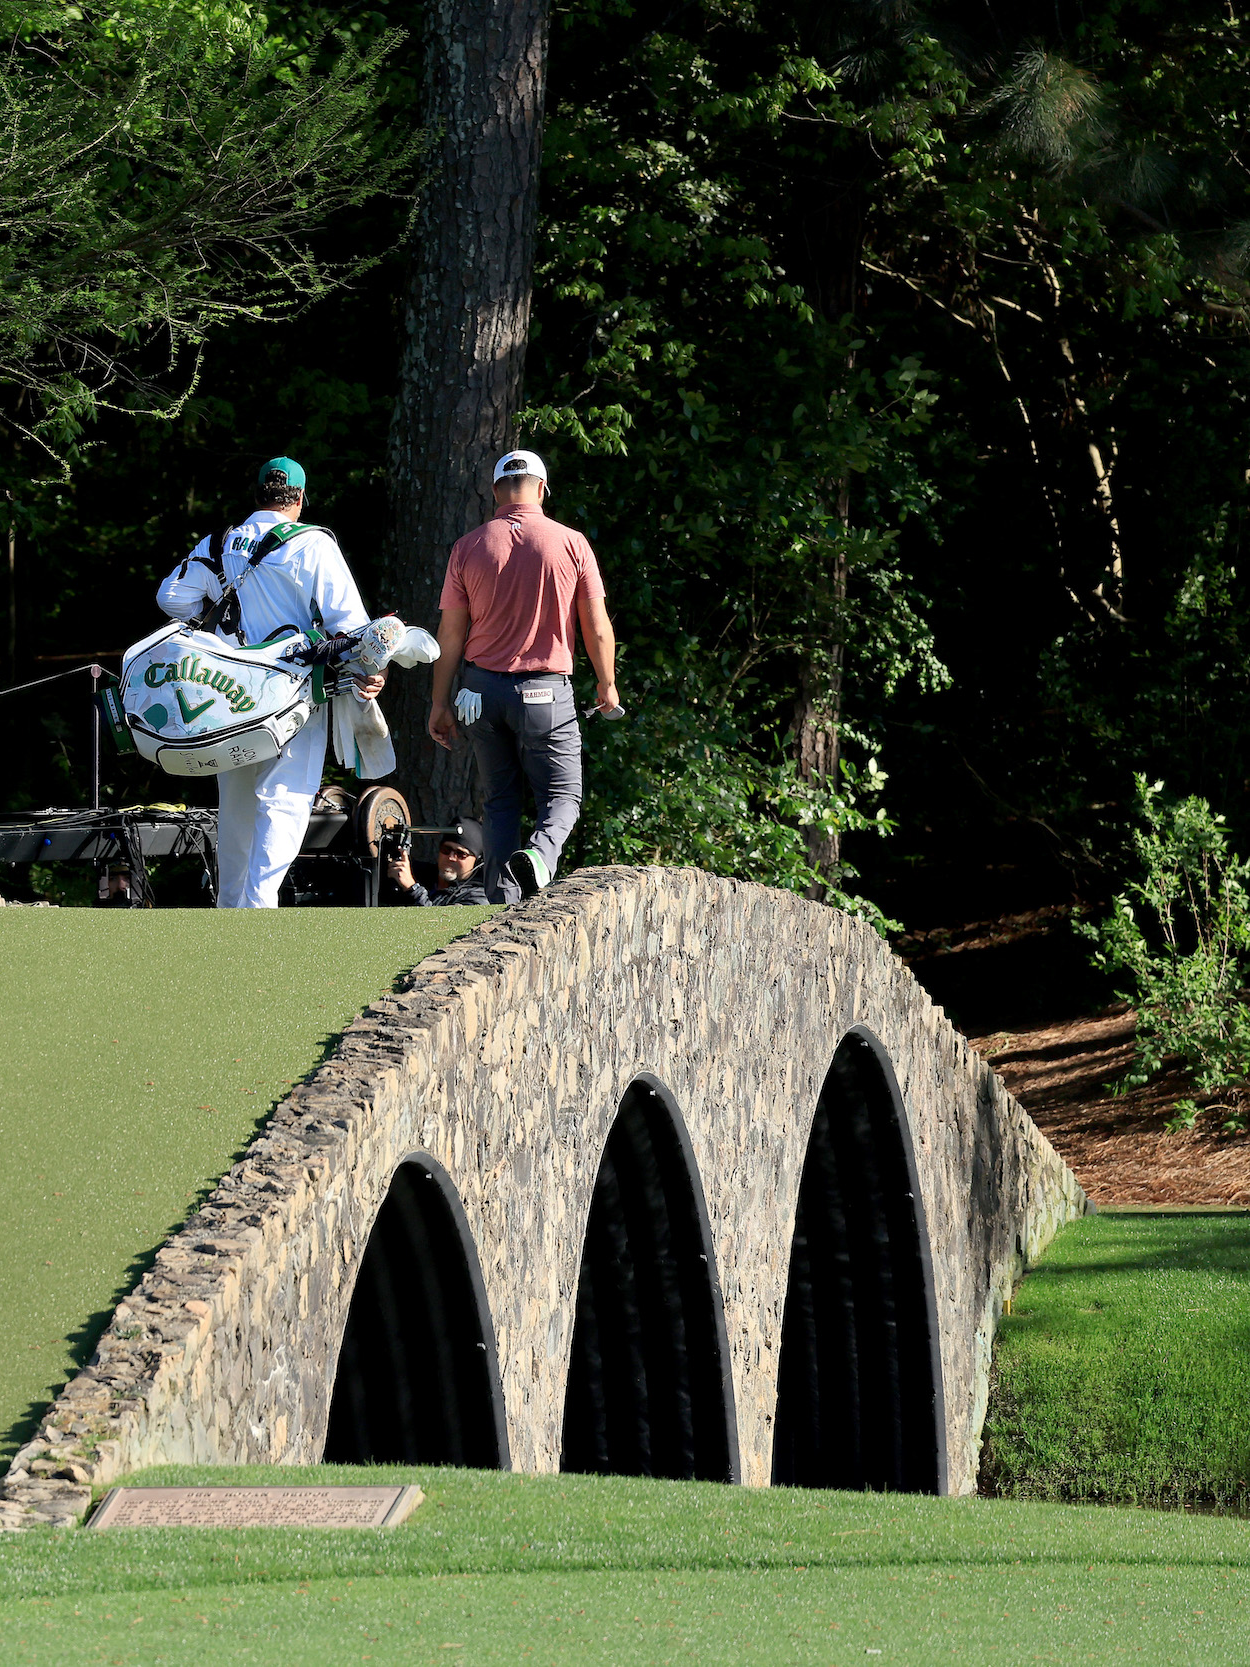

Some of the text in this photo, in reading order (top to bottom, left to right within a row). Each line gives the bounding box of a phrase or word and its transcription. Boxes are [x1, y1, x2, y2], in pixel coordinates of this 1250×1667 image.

[232, 536, 261, 554] RAH
[144, 655, 255, 713] Callaway
[525, 691, 551, 699] RAHMBO
